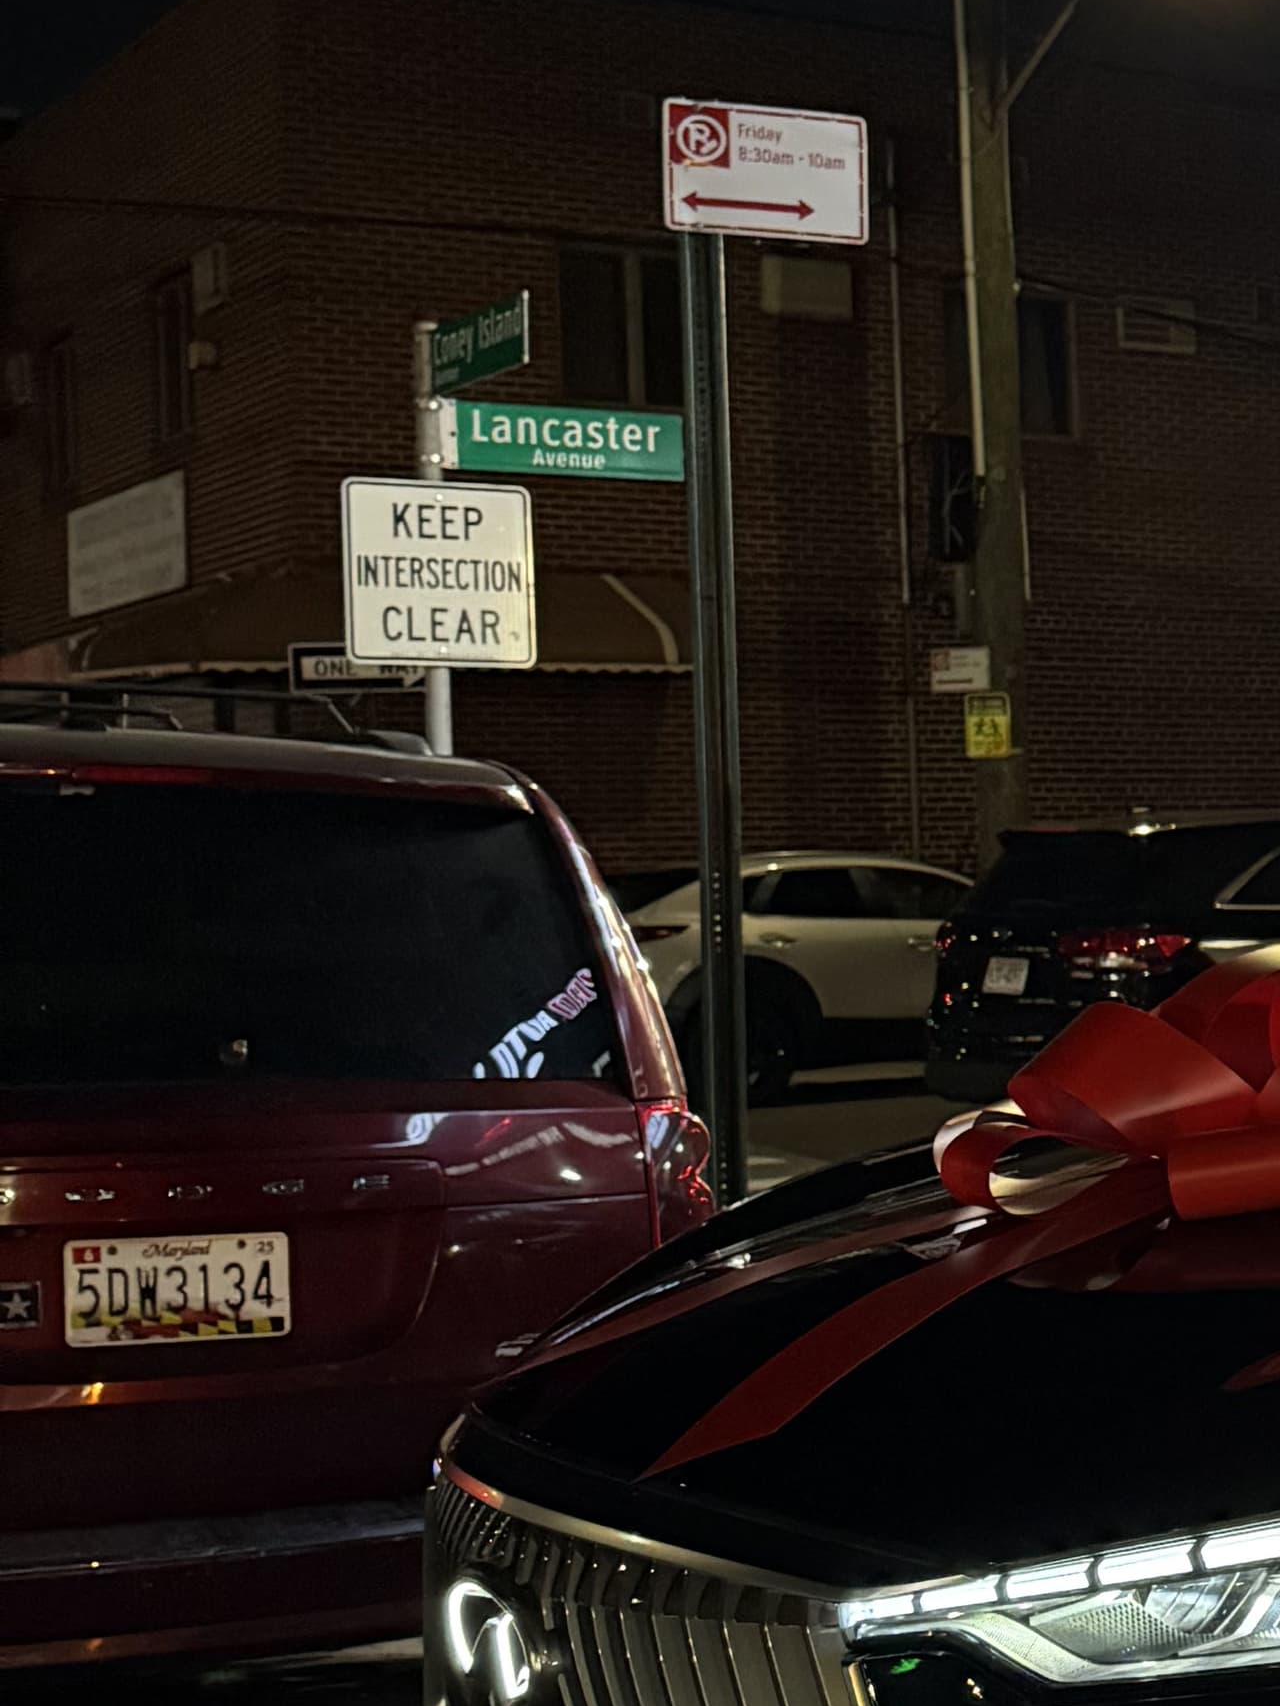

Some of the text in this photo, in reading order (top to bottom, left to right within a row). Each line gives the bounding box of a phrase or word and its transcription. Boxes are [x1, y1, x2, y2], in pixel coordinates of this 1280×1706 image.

[738, 124, 783, 144] Friday
[738, 146, 795, 166] 8:30am
[808, 153, 846, 170] 10am
[433, 298, 522, 365] Coney Island
[471, 409, 661, 453] Lancaster
[532, 448, 607, 470] Avenue
[392, 502, 484, 541] KEEP
[356, 554, 522, 593] INTERSECTION
[382, 605, 502, 645] CLEAR
[142, 1239, 211, 1261] Maryland
[256, 1240, 274, 1254] 25
[76, 1259, 275, 1320] 5DW3134
